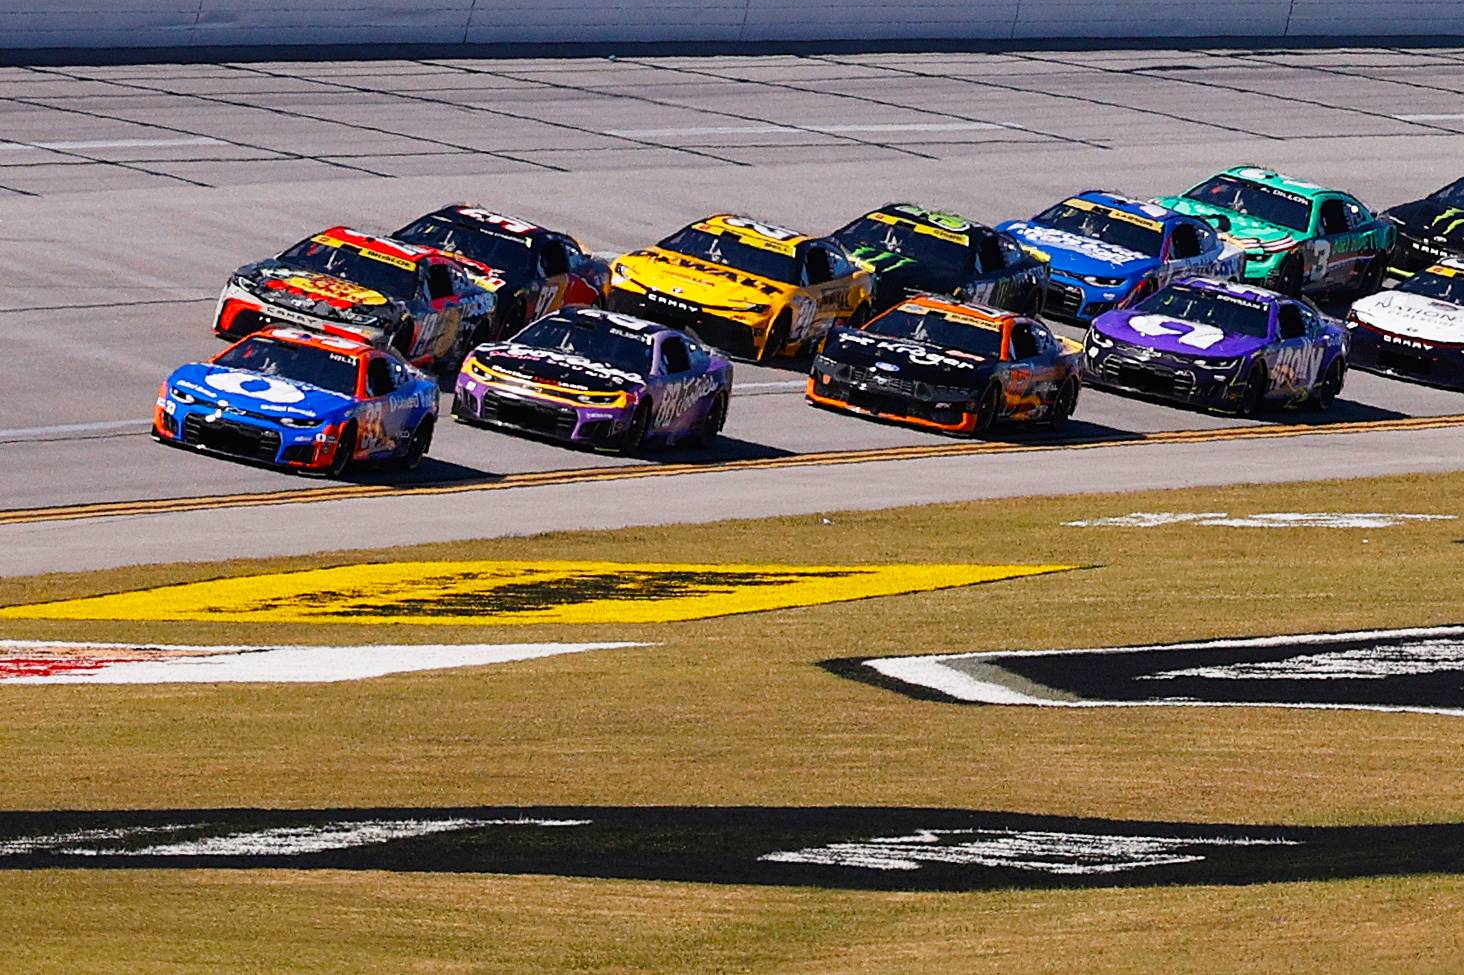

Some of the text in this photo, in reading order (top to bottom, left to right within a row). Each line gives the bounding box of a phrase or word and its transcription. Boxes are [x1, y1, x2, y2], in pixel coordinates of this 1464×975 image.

[1272, 189, 1309, 206] DILLON
[647, 292, 698, 313] CAMRY
[1216, 294, 1261, 310] BOWMAN
[265, 306, 318, 326] CAMRY
[1383, 334, 1434, 351] CAMRY
[876, 340, 975, 371] Kroger
